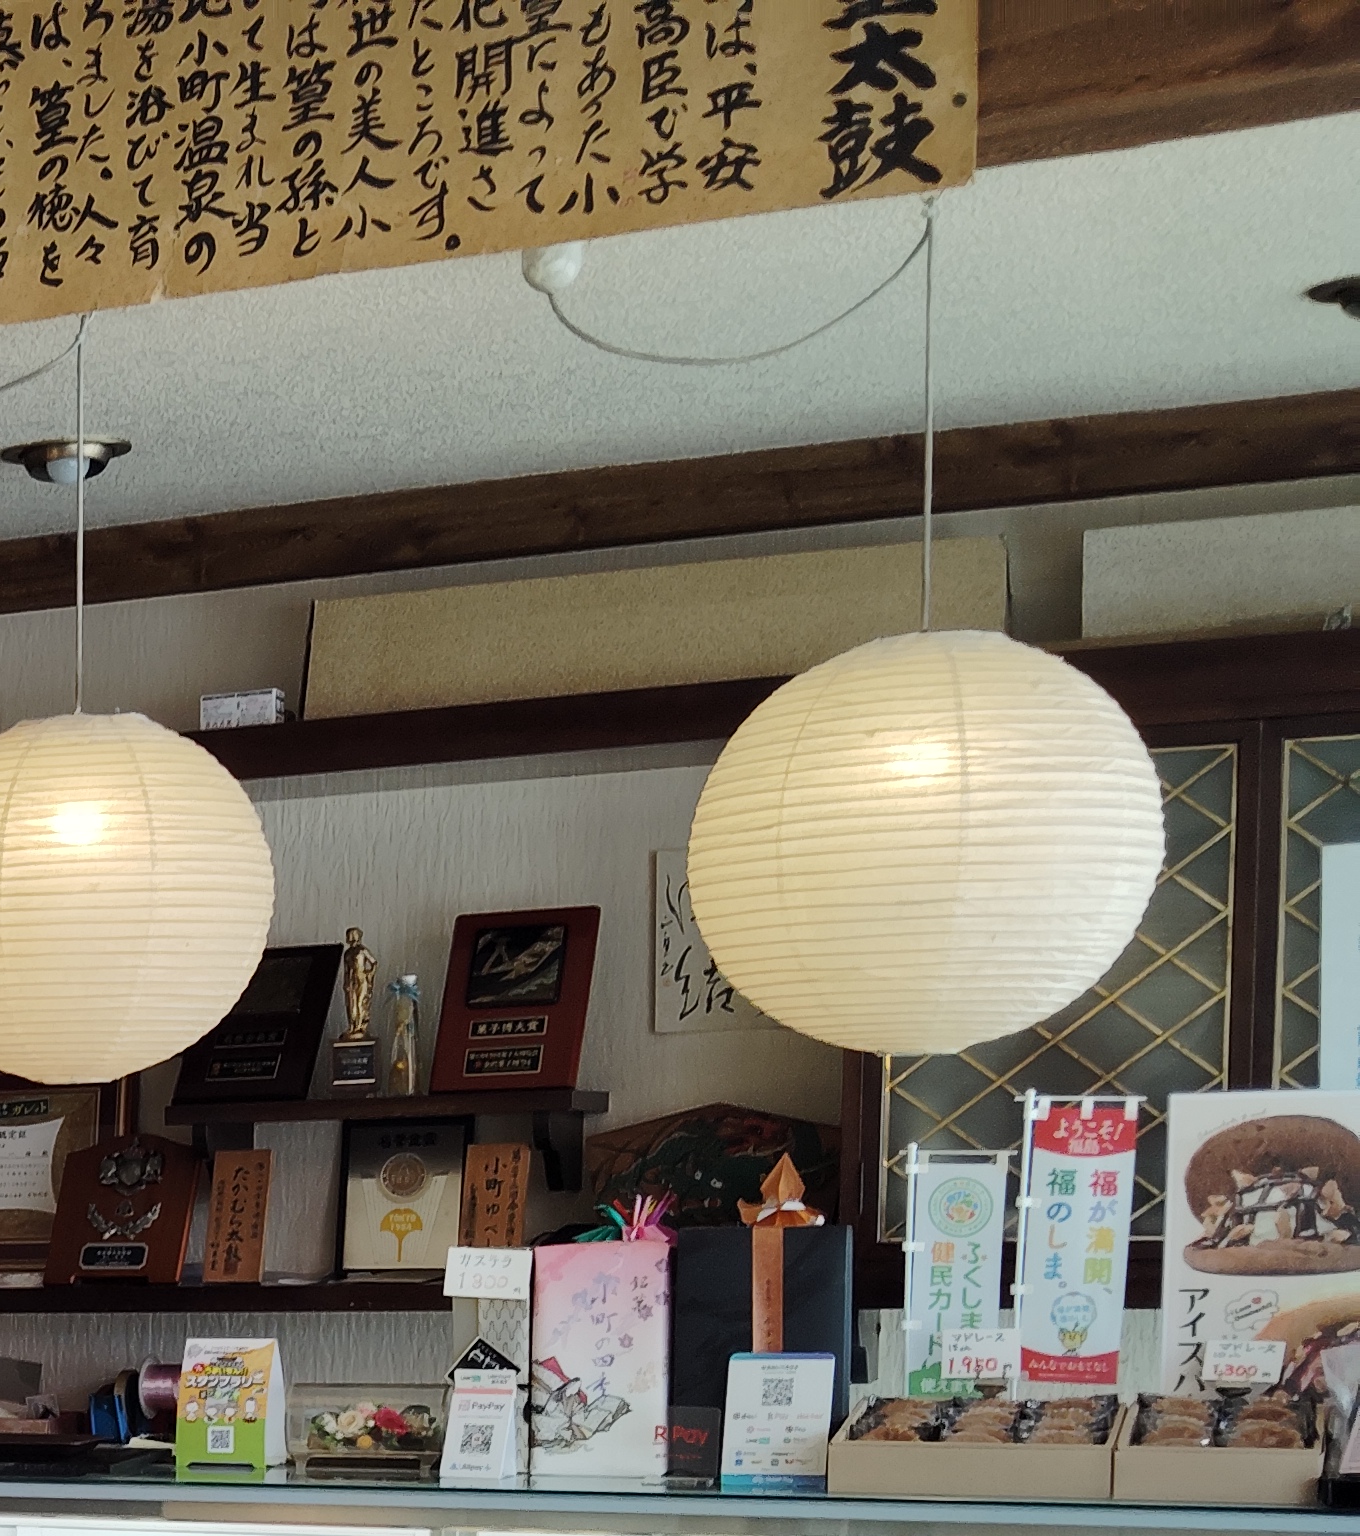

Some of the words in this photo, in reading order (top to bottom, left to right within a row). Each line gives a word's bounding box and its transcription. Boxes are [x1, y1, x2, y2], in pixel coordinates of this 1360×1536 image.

[228, 0, 277, 257] て生まれ当
[276, 0, 339, 259] は篁の孫と
[331, 0, 402, 243] 世の美人小
[696, 0, 762, 191] は、平安
[814, 0, 944, 200] 太鼓
[1043, 1167, 1079, 1288] 福のしま。
